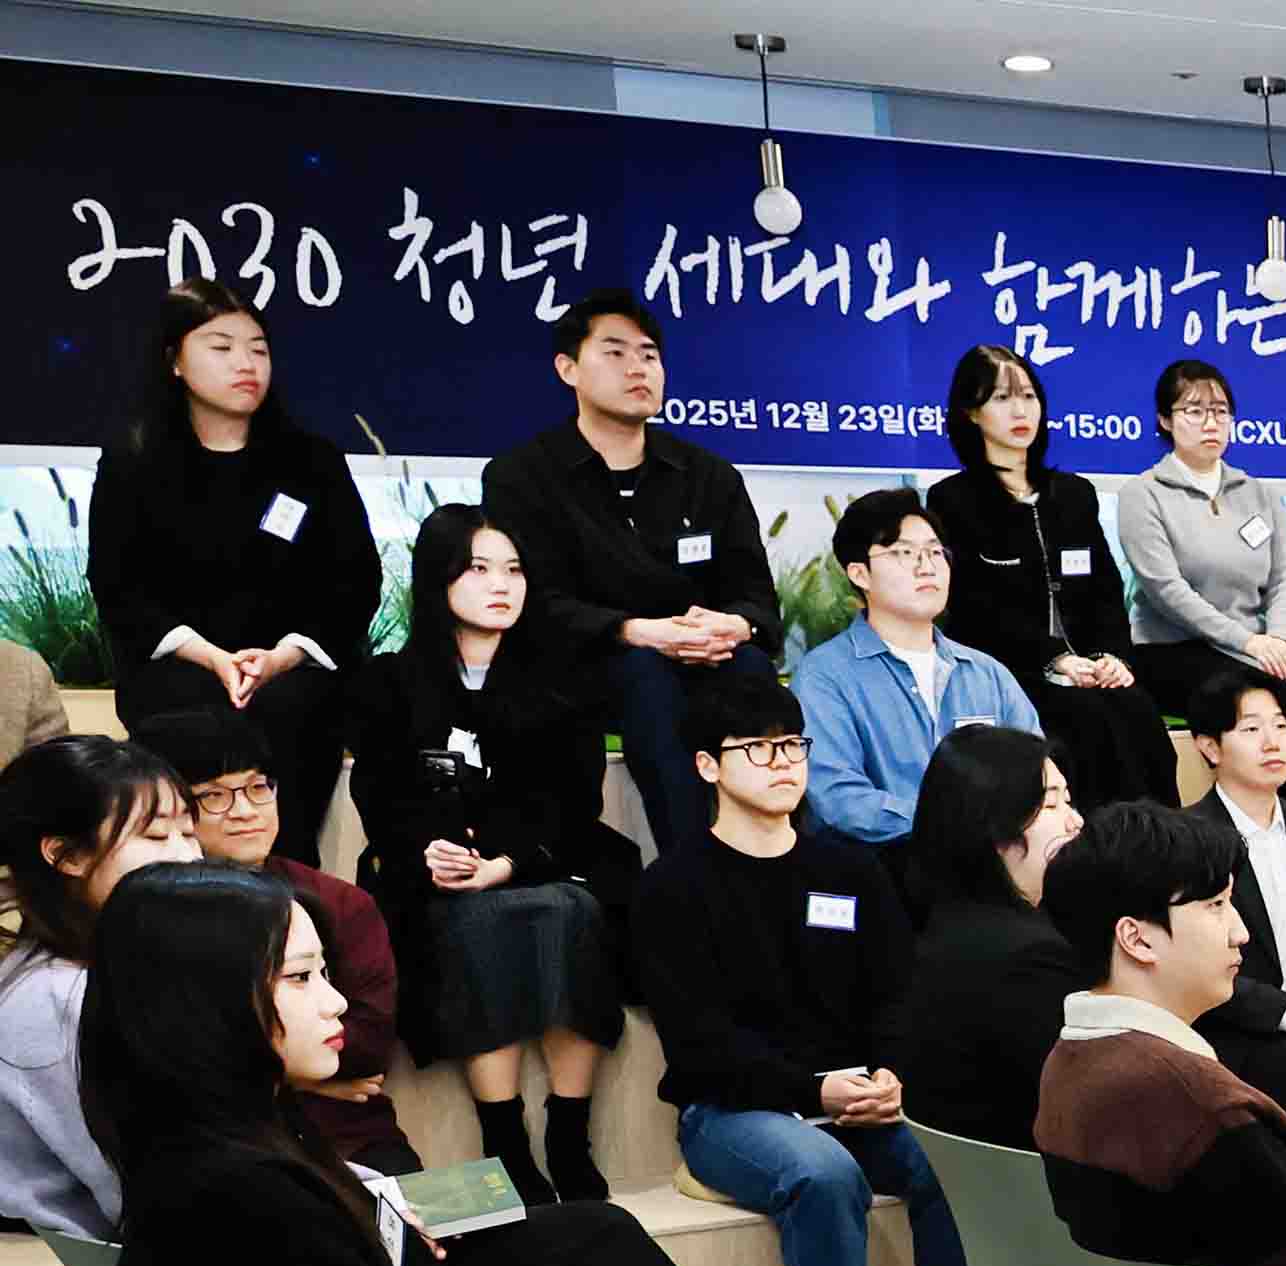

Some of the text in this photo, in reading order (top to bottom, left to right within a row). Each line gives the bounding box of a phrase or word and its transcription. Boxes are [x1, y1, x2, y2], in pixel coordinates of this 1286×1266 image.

[67, 198, 343, 310] 2030
[388, 187, 588, 323] 청년
[644, 223, 952, 323] 세대와
[766, 403, 830, 433] 12월
[838, 404, 949, 438] 23일(화
